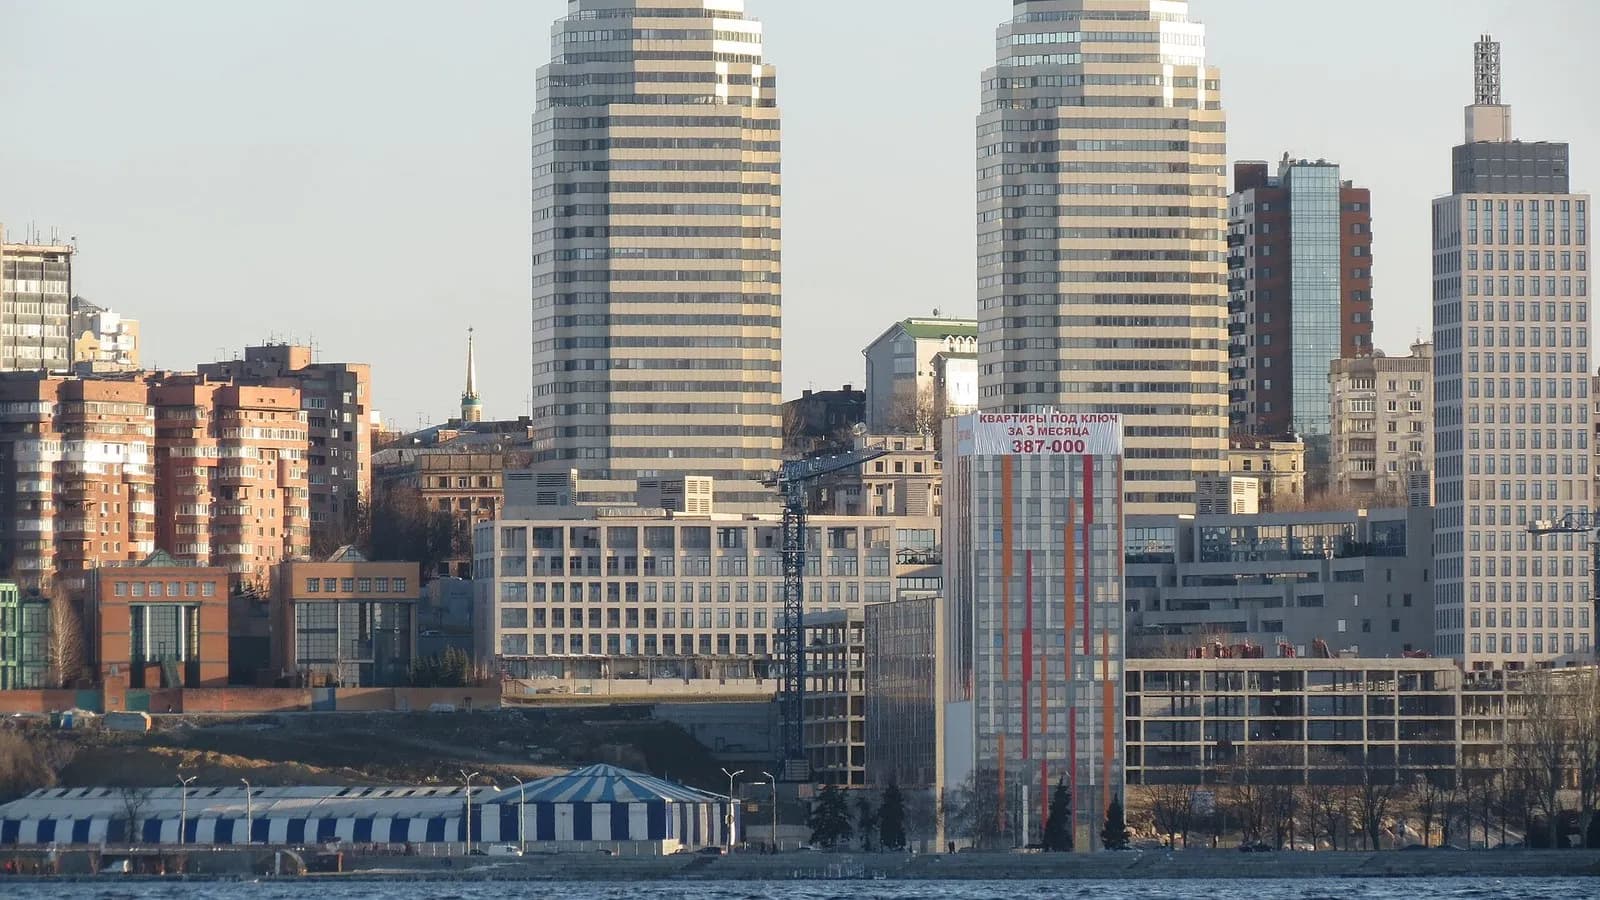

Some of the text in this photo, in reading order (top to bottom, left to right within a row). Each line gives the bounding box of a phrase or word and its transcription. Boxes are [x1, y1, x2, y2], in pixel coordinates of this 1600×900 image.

[979, 414, 1118, 425] КВАРТИРЫ ПОД КЛЮЧ
[1007, 426, 1090, 437] ЗА 3 МЕСЯЦА
[1012, 439, 1086, 453] 387-000
